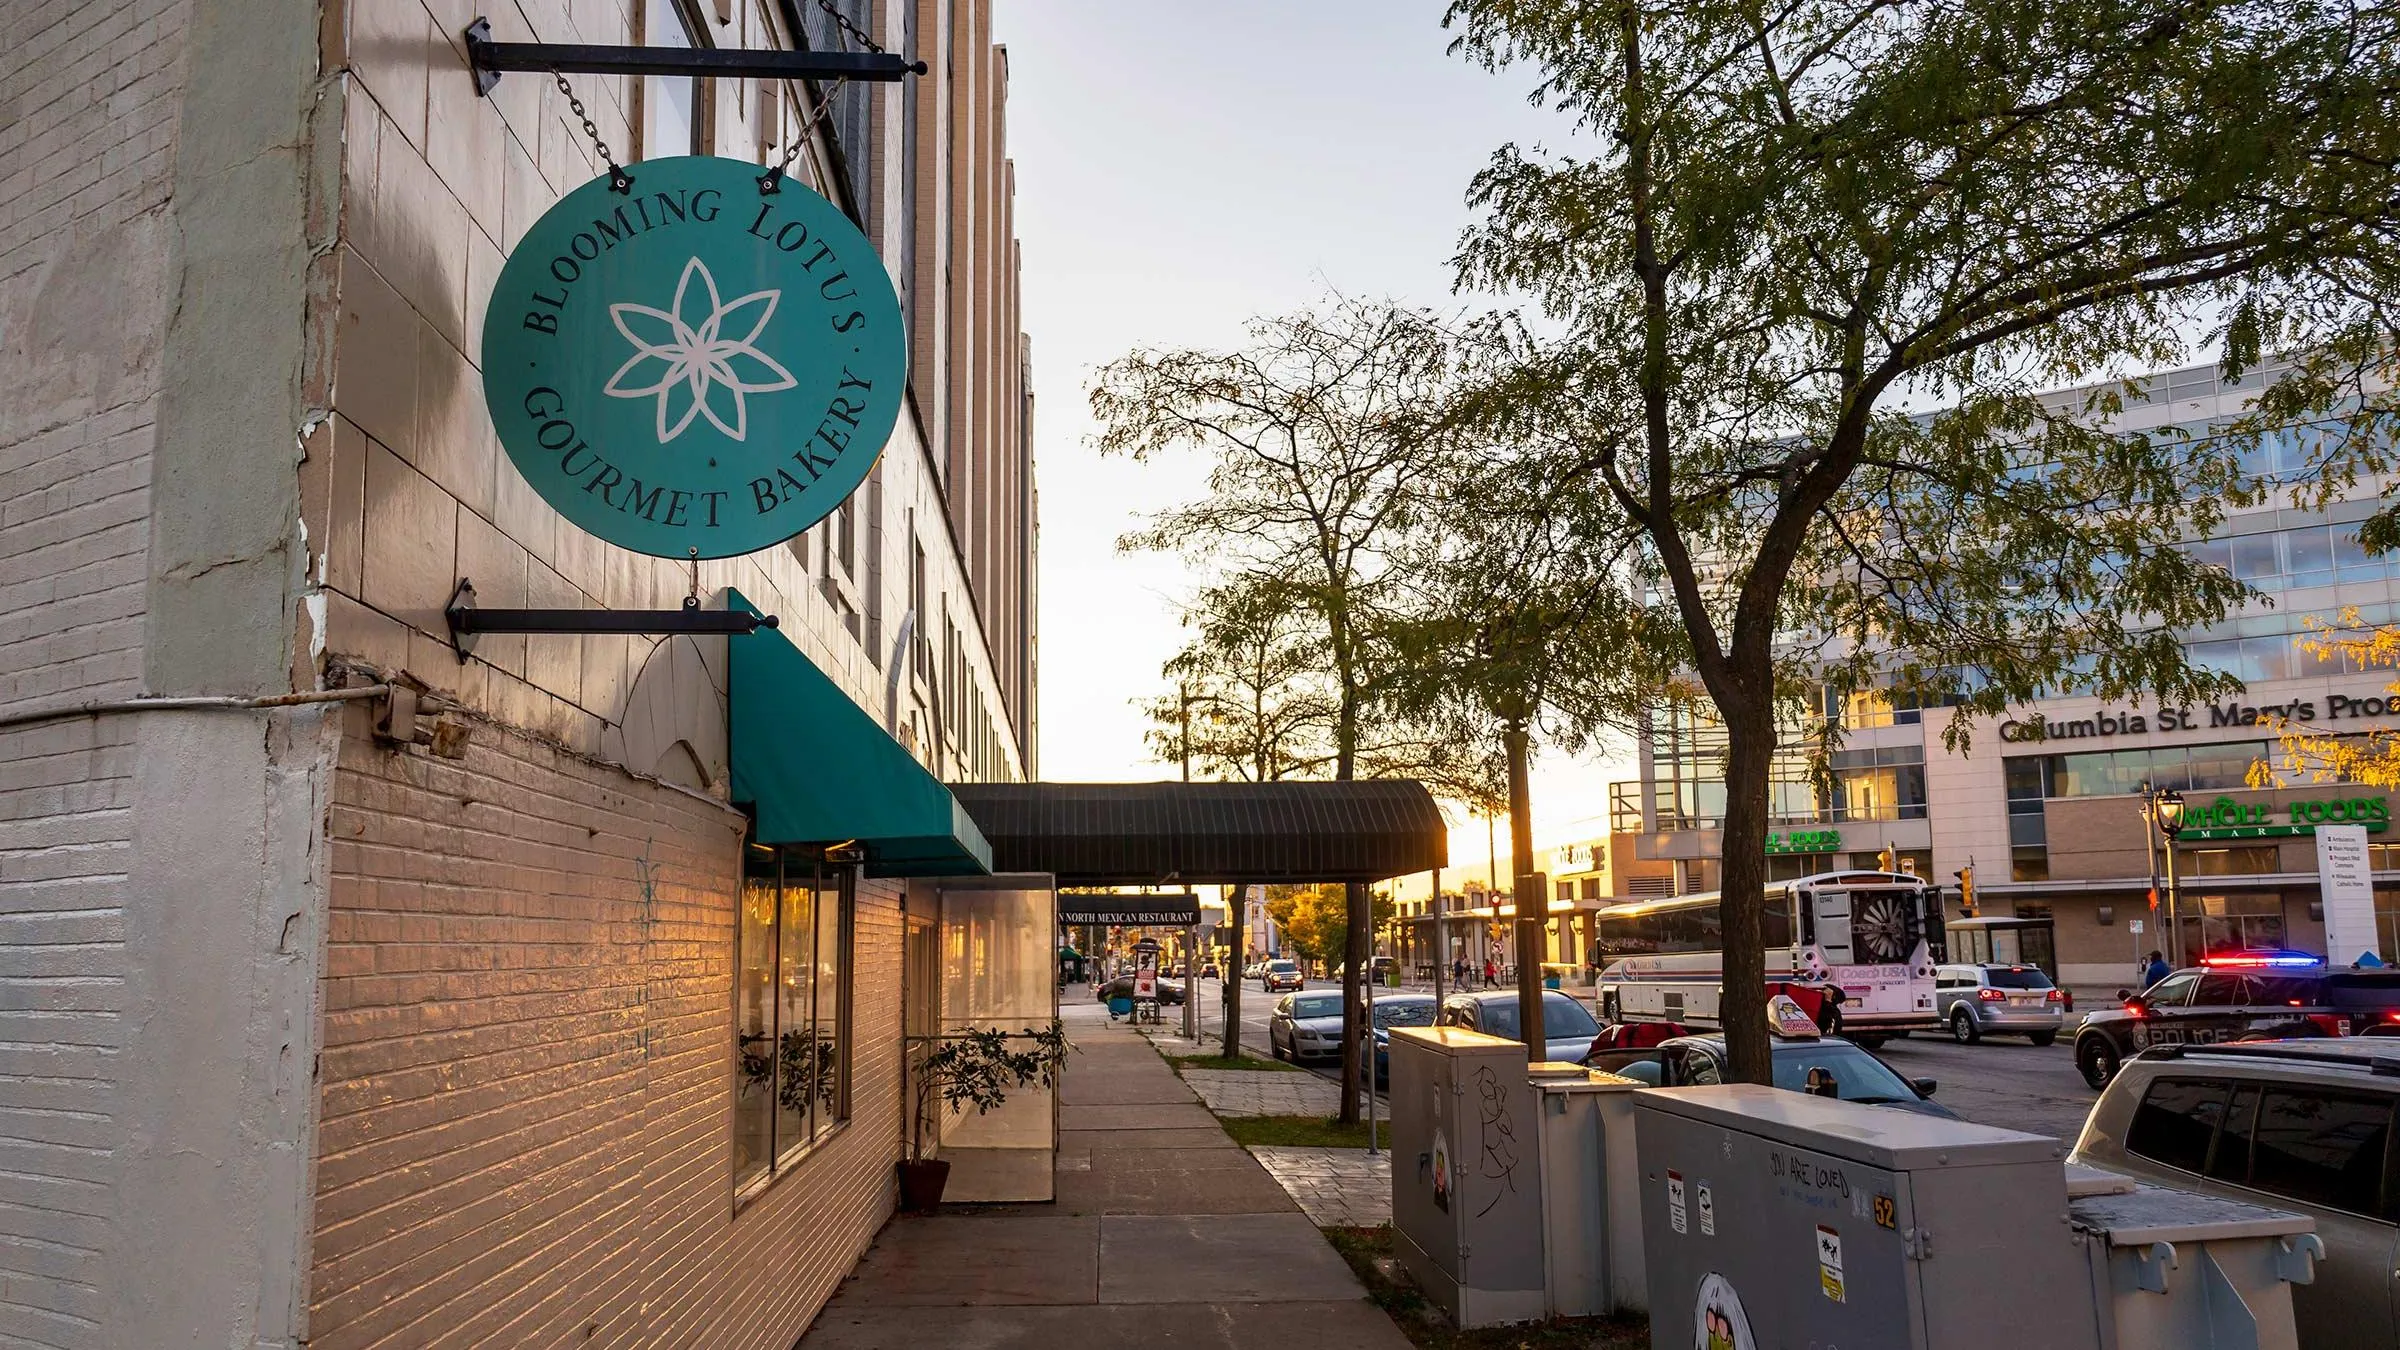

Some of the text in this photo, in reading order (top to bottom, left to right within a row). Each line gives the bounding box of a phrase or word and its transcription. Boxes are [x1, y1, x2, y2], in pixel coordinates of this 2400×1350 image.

[523, 189, 865, 337] BLOOMING LOTUS
[524, 366, 872, 527] GOURMET BAKERY
[2157, 707, 2198, 731] St.
[2210, 698, 2315, 728] Mary's
[2176, 796, 2389, 827] WHOLE FOODS
[1789, 831, 1841, 845] FOODS
[2201, 826, 2300, 839] MARK
[1066, 912, 1095, 922] NORTH
[1098, 912, 1137, 922] MEXICAN
[1139, 912, 1193, 922] RESTAURANT
[1840, 967, 1907, 978] Coach USA
[2150, 1029, 2229, 1045] POLICE
[1770, 1151, 1785, 1176] YOU
[1790, 1156, 1811, 1186] ARE
[1815, 1166, 1849, 1198] LOVED
[1874, 1195, 1896, 1230] 52
